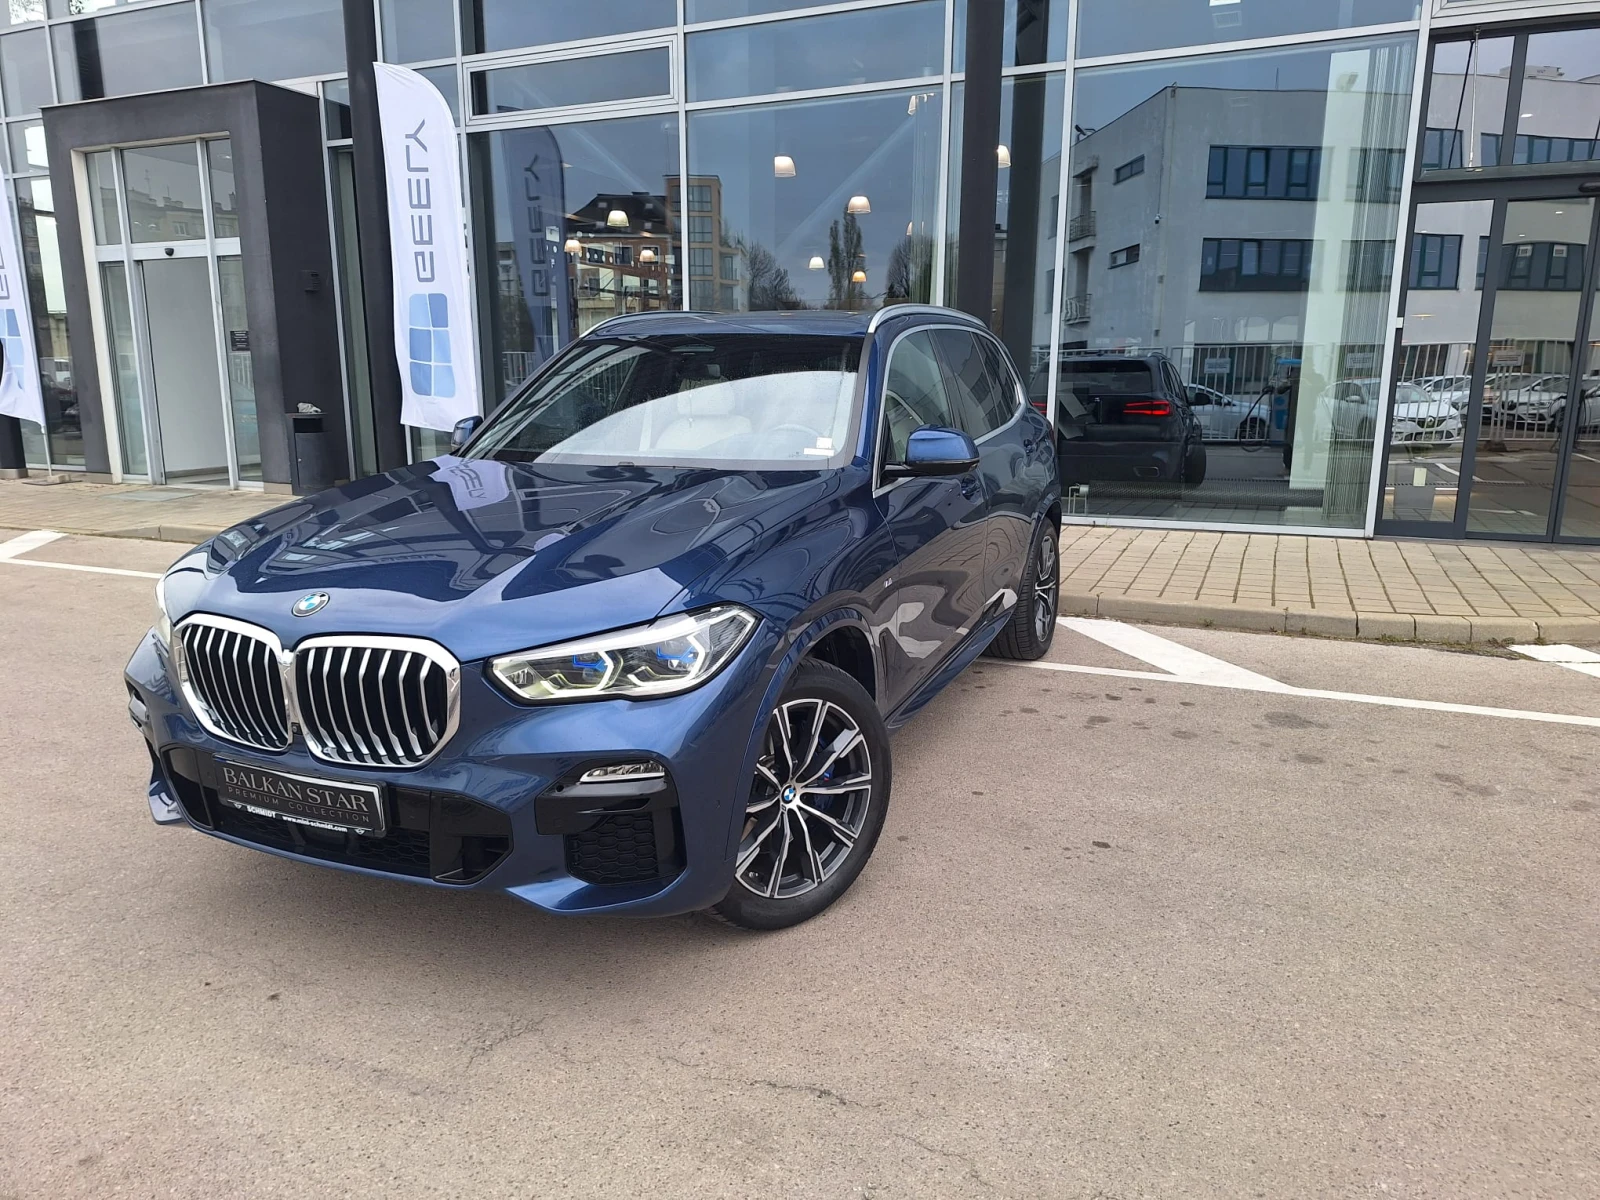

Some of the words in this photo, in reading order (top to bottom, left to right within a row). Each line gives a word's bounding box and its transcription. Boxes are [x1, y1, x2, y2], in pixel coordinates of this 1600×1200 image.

[222, 767, 302, 801] BALKAN
[306, 787, 369, 812] STAR
[228, 786, 279, 805] PREMIUM
[288, 801, 369, 822] COLLECTION
[246, 804, 276, 818] SCHMIDT
